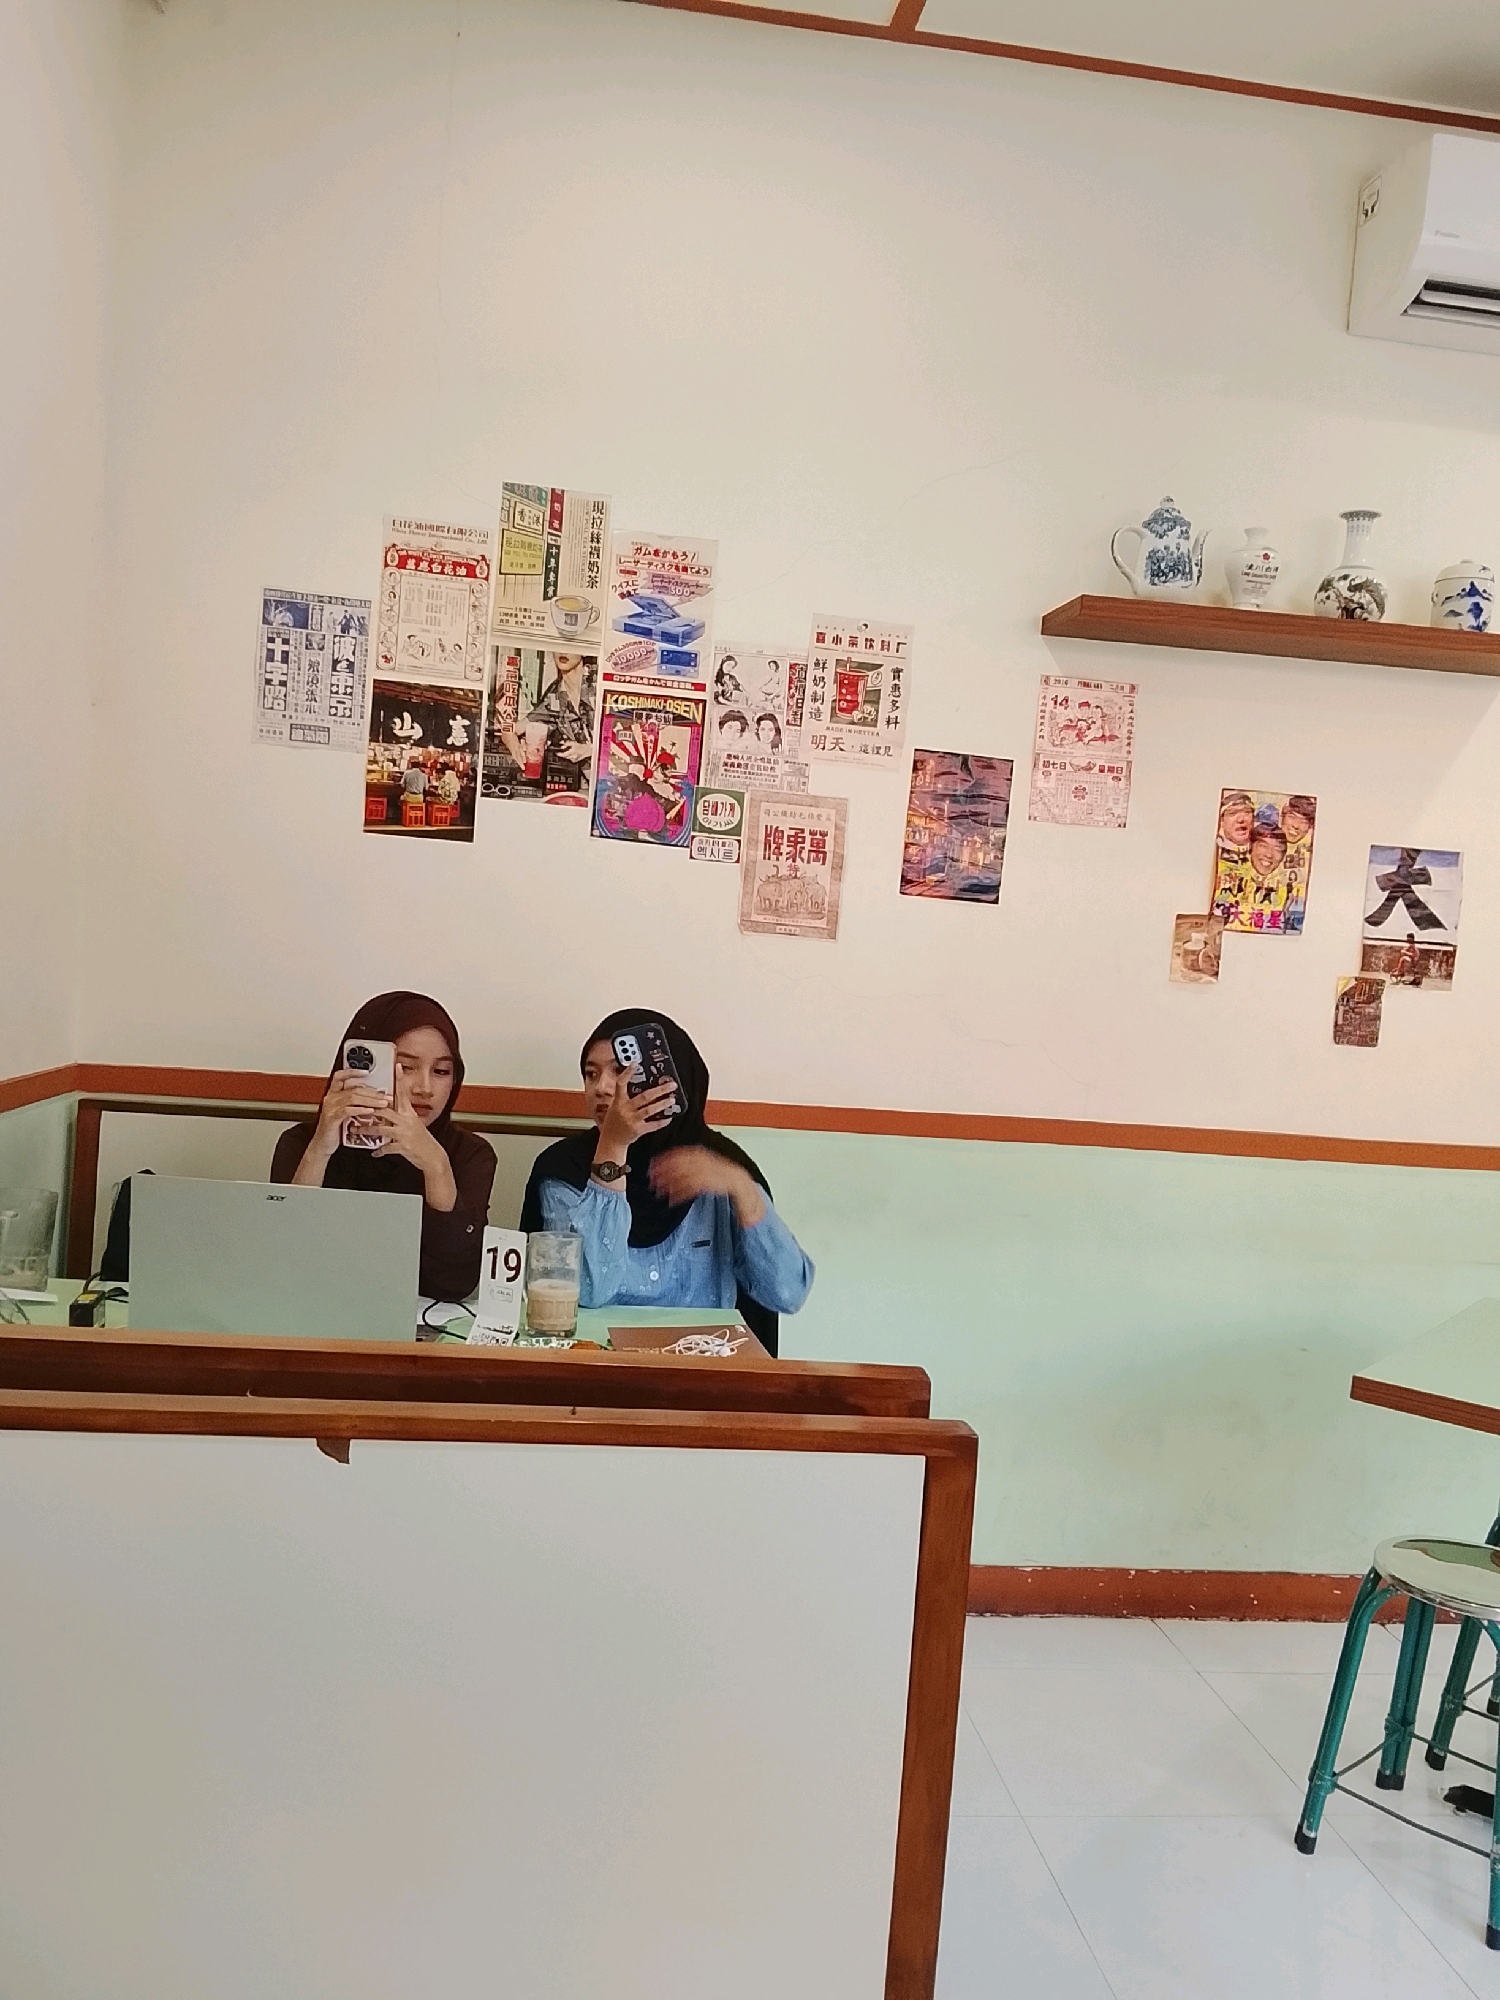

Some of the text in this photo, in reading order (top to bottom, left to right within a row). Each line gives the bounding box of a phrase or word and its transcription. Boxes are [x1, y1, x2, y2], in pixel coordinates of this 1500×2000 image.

[702, 800, 735, 818] 담배가게
[697, 846, 733, 860] 엑시트
[266, 1194, 287, 1202] acer
[486, 1246, 522, 1283] 19
